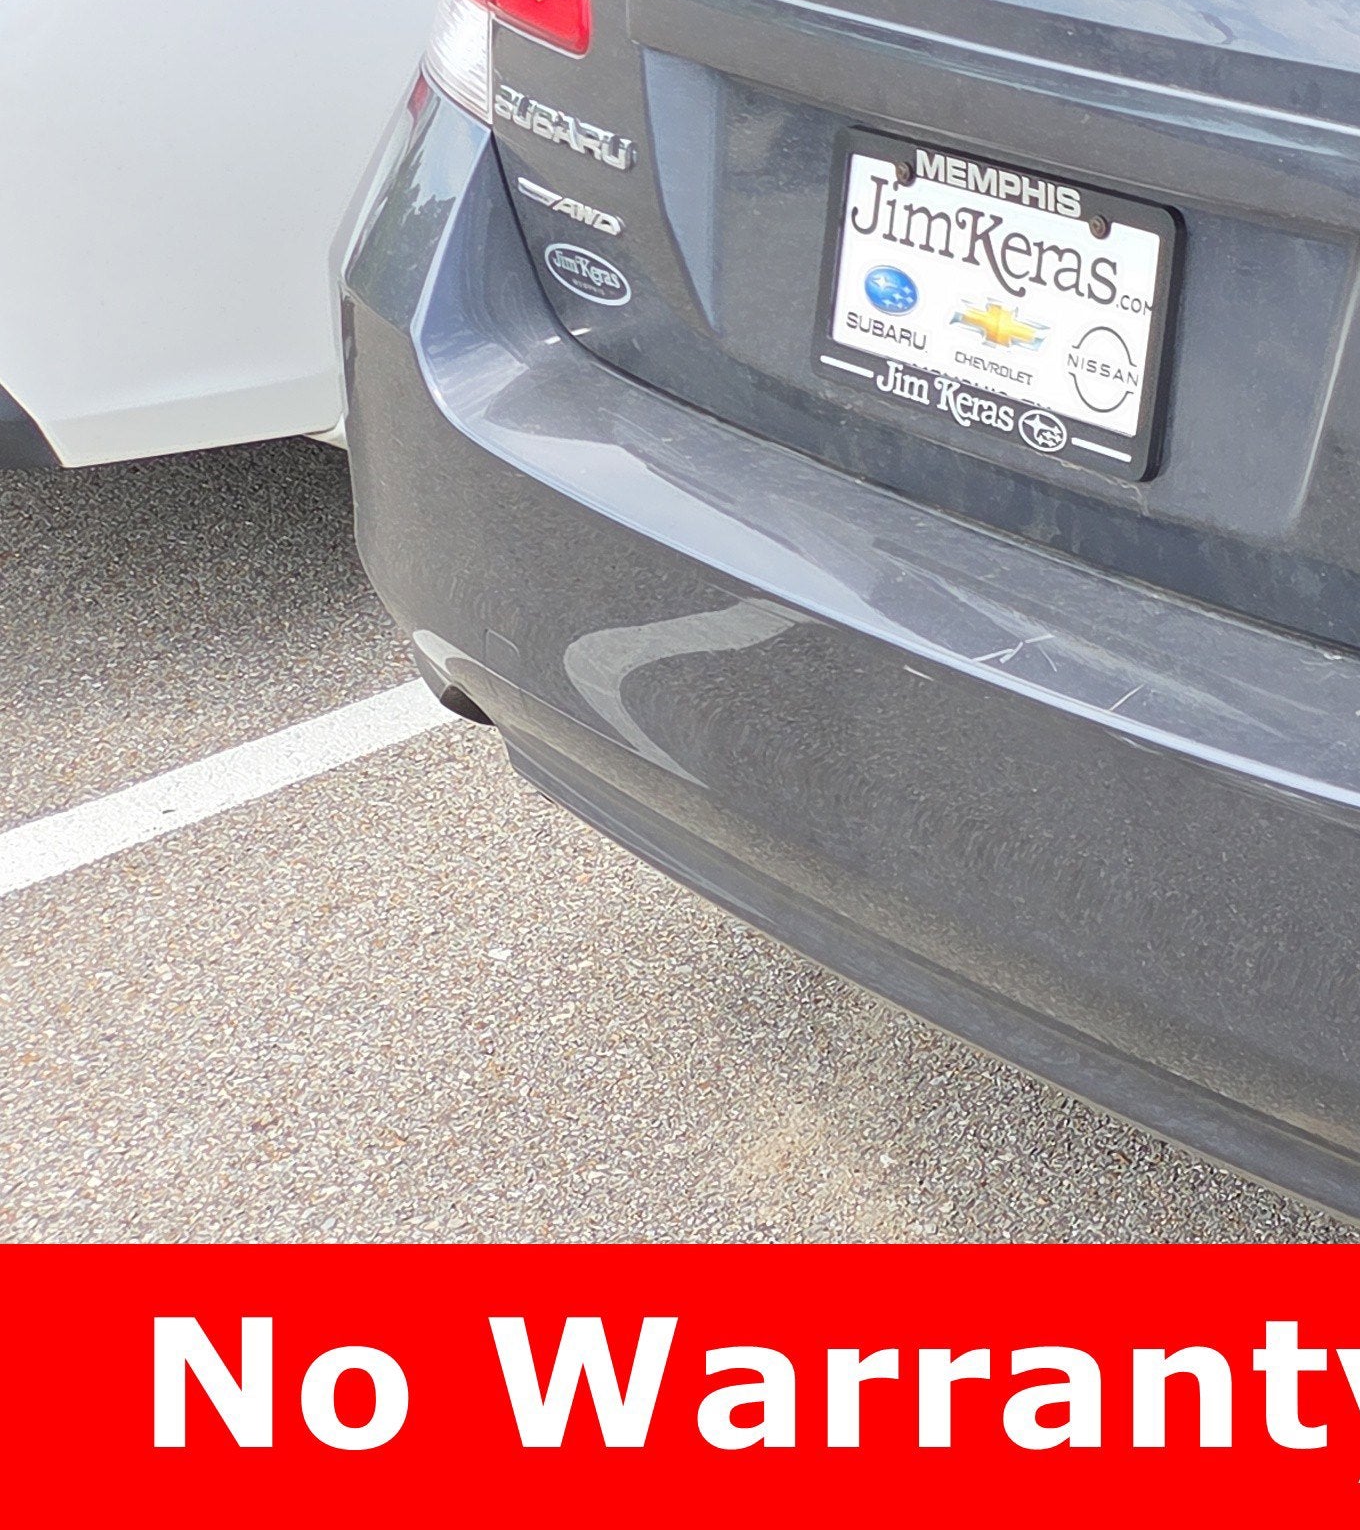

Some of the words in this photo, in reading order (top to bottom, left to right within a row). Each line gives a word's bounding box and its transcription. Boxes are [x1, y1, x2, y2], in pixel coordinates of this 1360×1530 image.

[495, 84, 638, 170] SUBARU
[916, 149, 1082, 218] MEMPHIS
[846, 312, 926, 350] SUBARU
[876, 360, 930, 406] Jim
[934, 374, 1015, 427] Keras
[954, 351, 1034, 386] CHEVROLET
[1067, 353, 1139, 387] NISSAN
